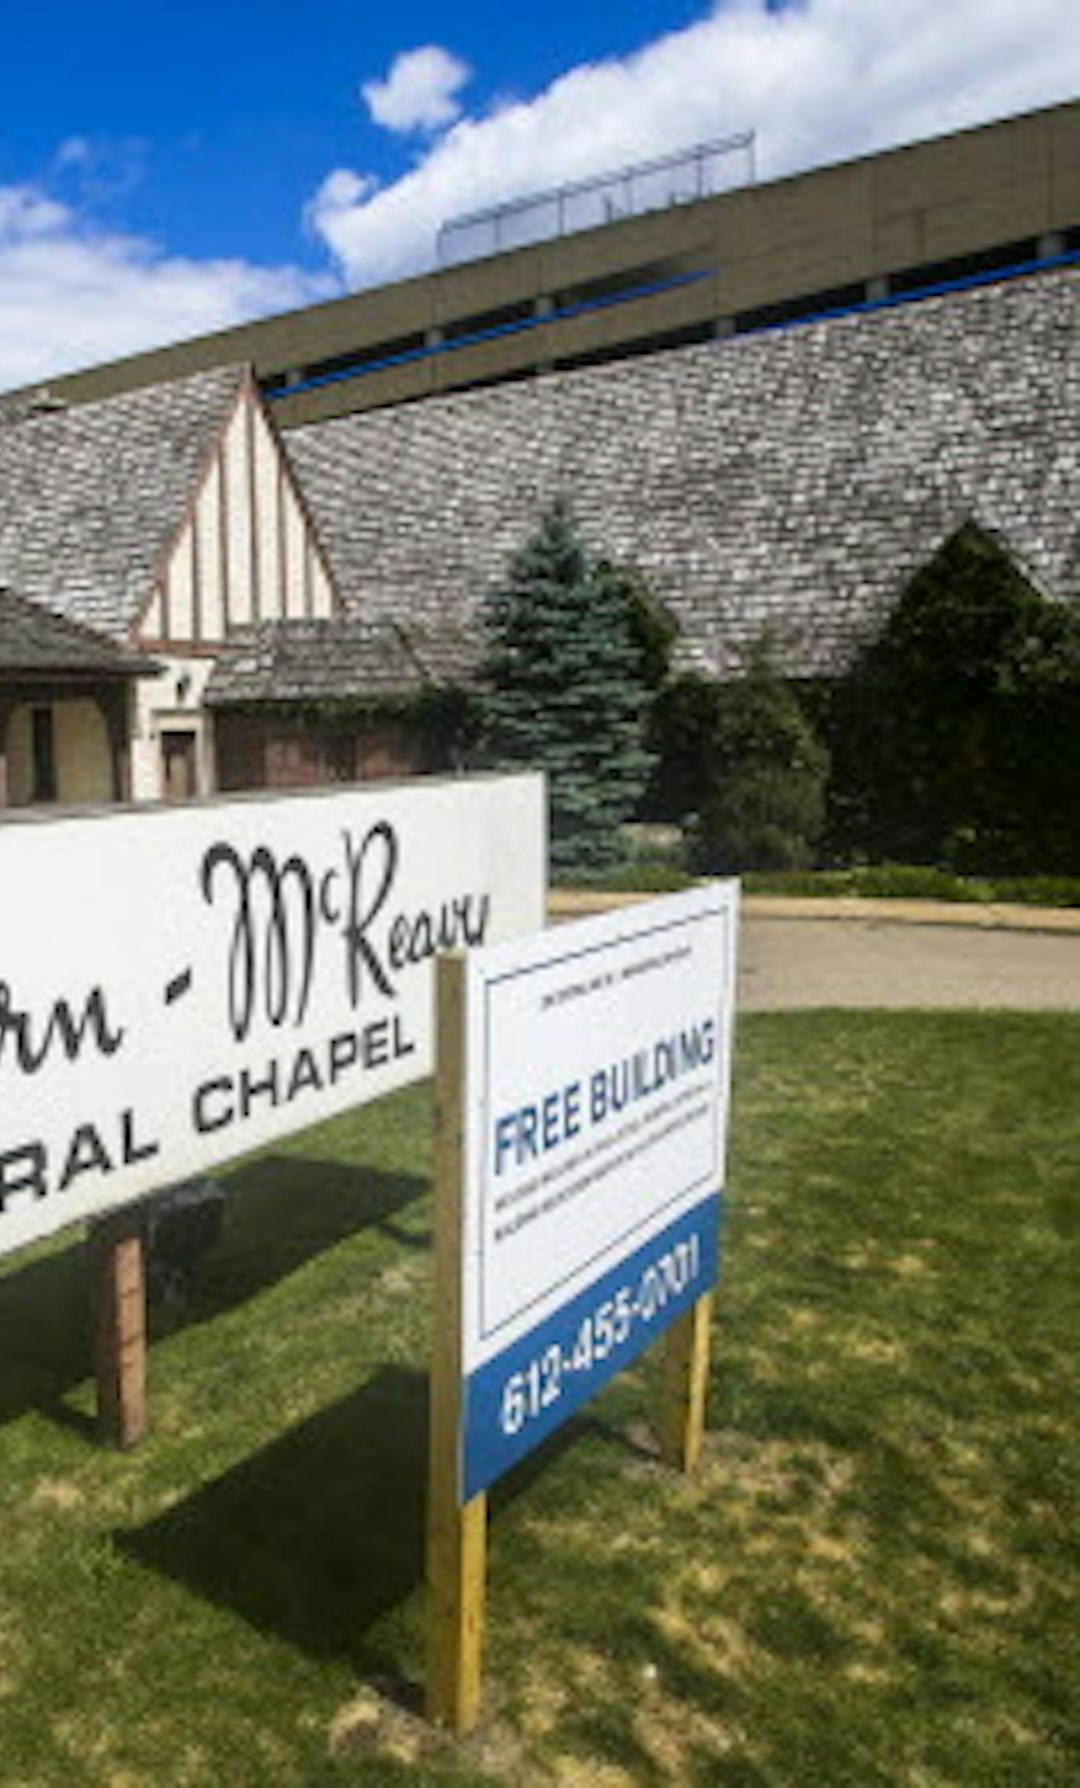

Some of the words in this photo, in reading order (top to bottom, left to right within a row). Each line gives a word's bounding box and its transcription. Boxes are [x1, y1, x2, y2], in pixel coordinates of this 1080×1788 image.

[200, 820, 490, 1043] McReavy
[191, 1015, 415, 1135] CHAPEL
[493, 1081, 581, 1177] FREE
[589, 1020, 714, 1124] BUILDING
